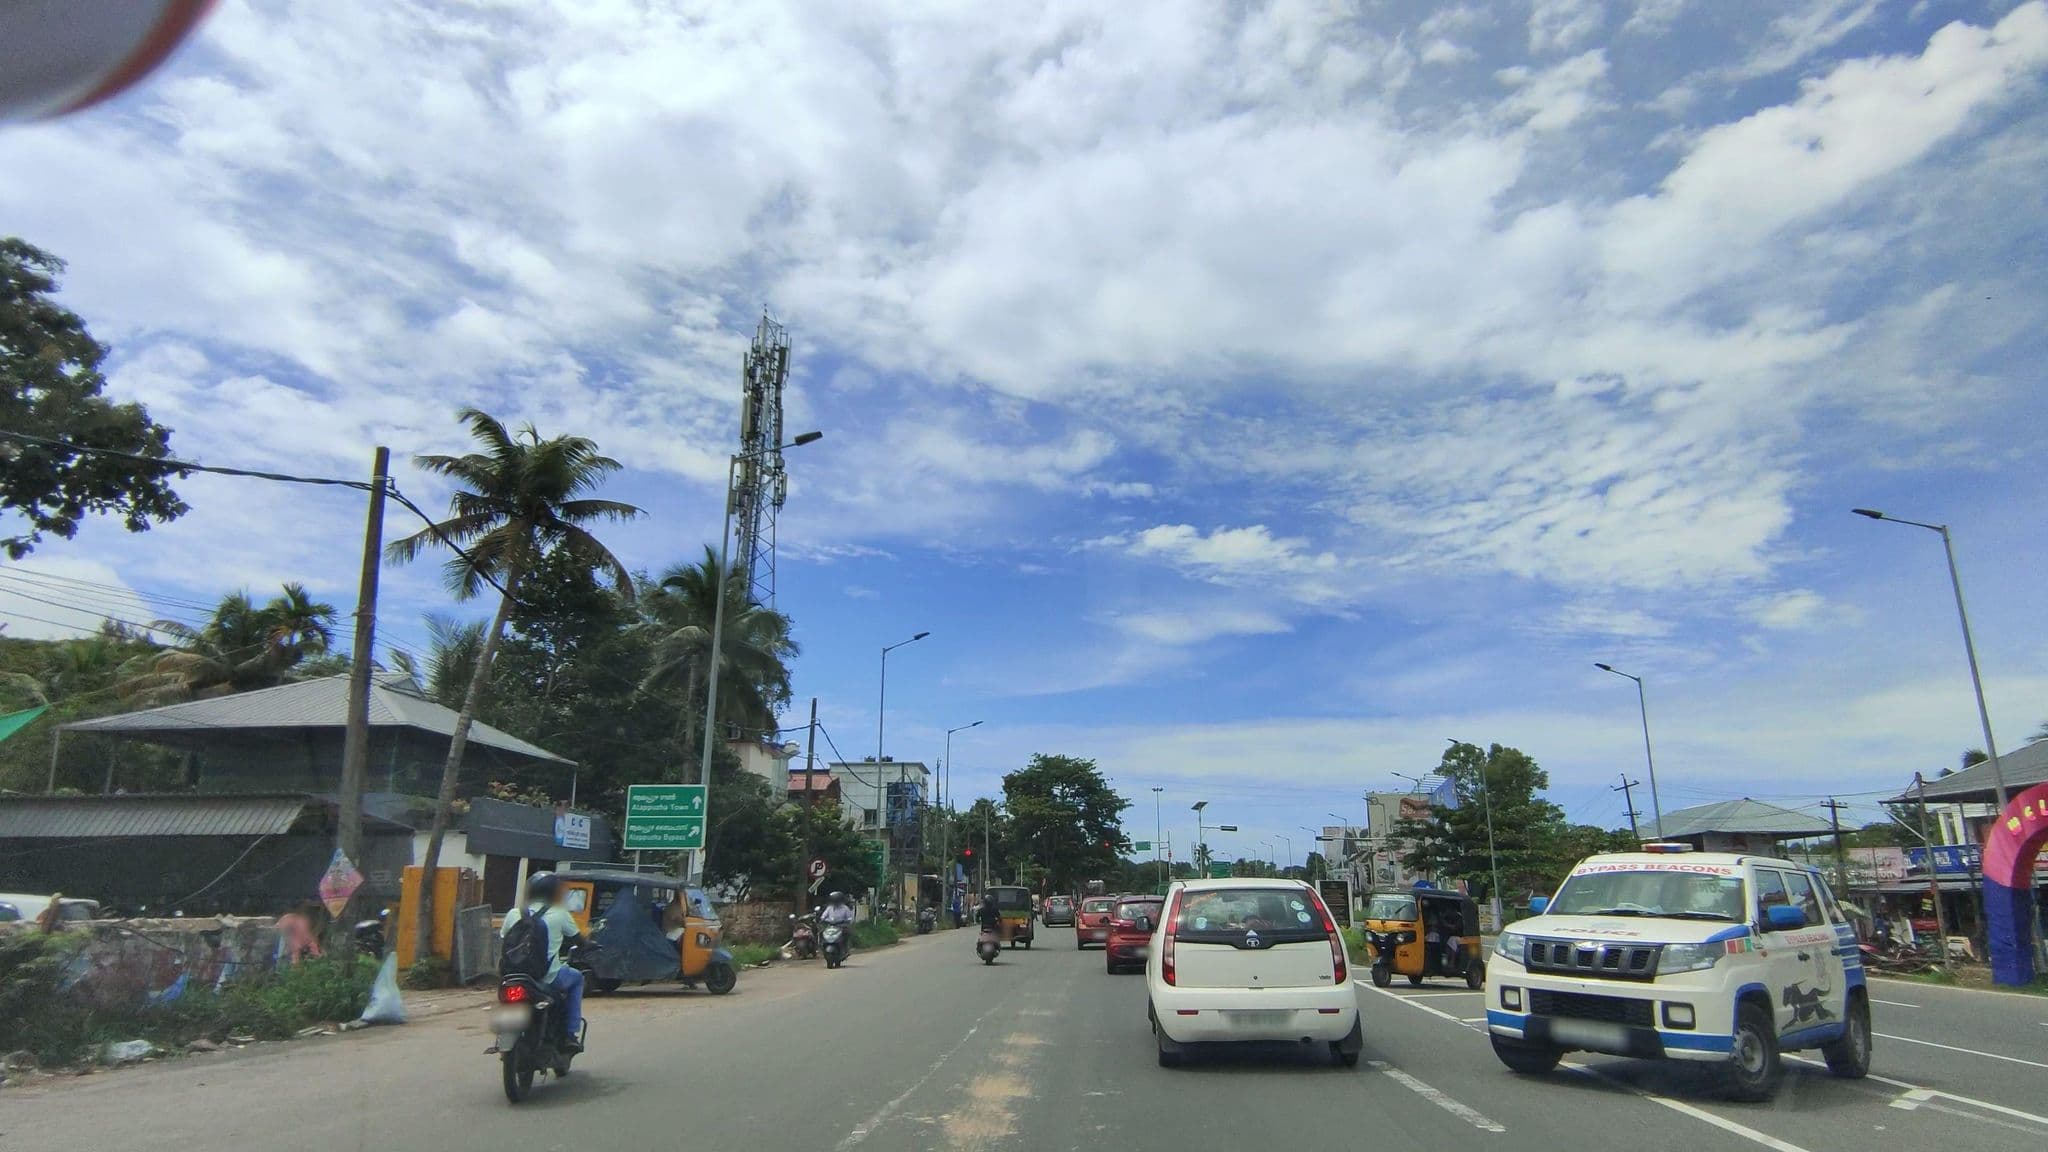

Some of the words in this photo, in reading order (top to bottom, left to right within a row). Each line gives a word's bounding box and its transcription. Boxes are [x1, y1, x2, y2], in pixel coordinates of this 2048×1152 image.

[671, 803, 689, 811] Town
[663, 833, 686, 842] Bypass
[1577, 863, 1639, 875] BYPASS
[1644, 863, 1732, 875] BEACONS
[1553, 927, 1640, 937] POLICE
